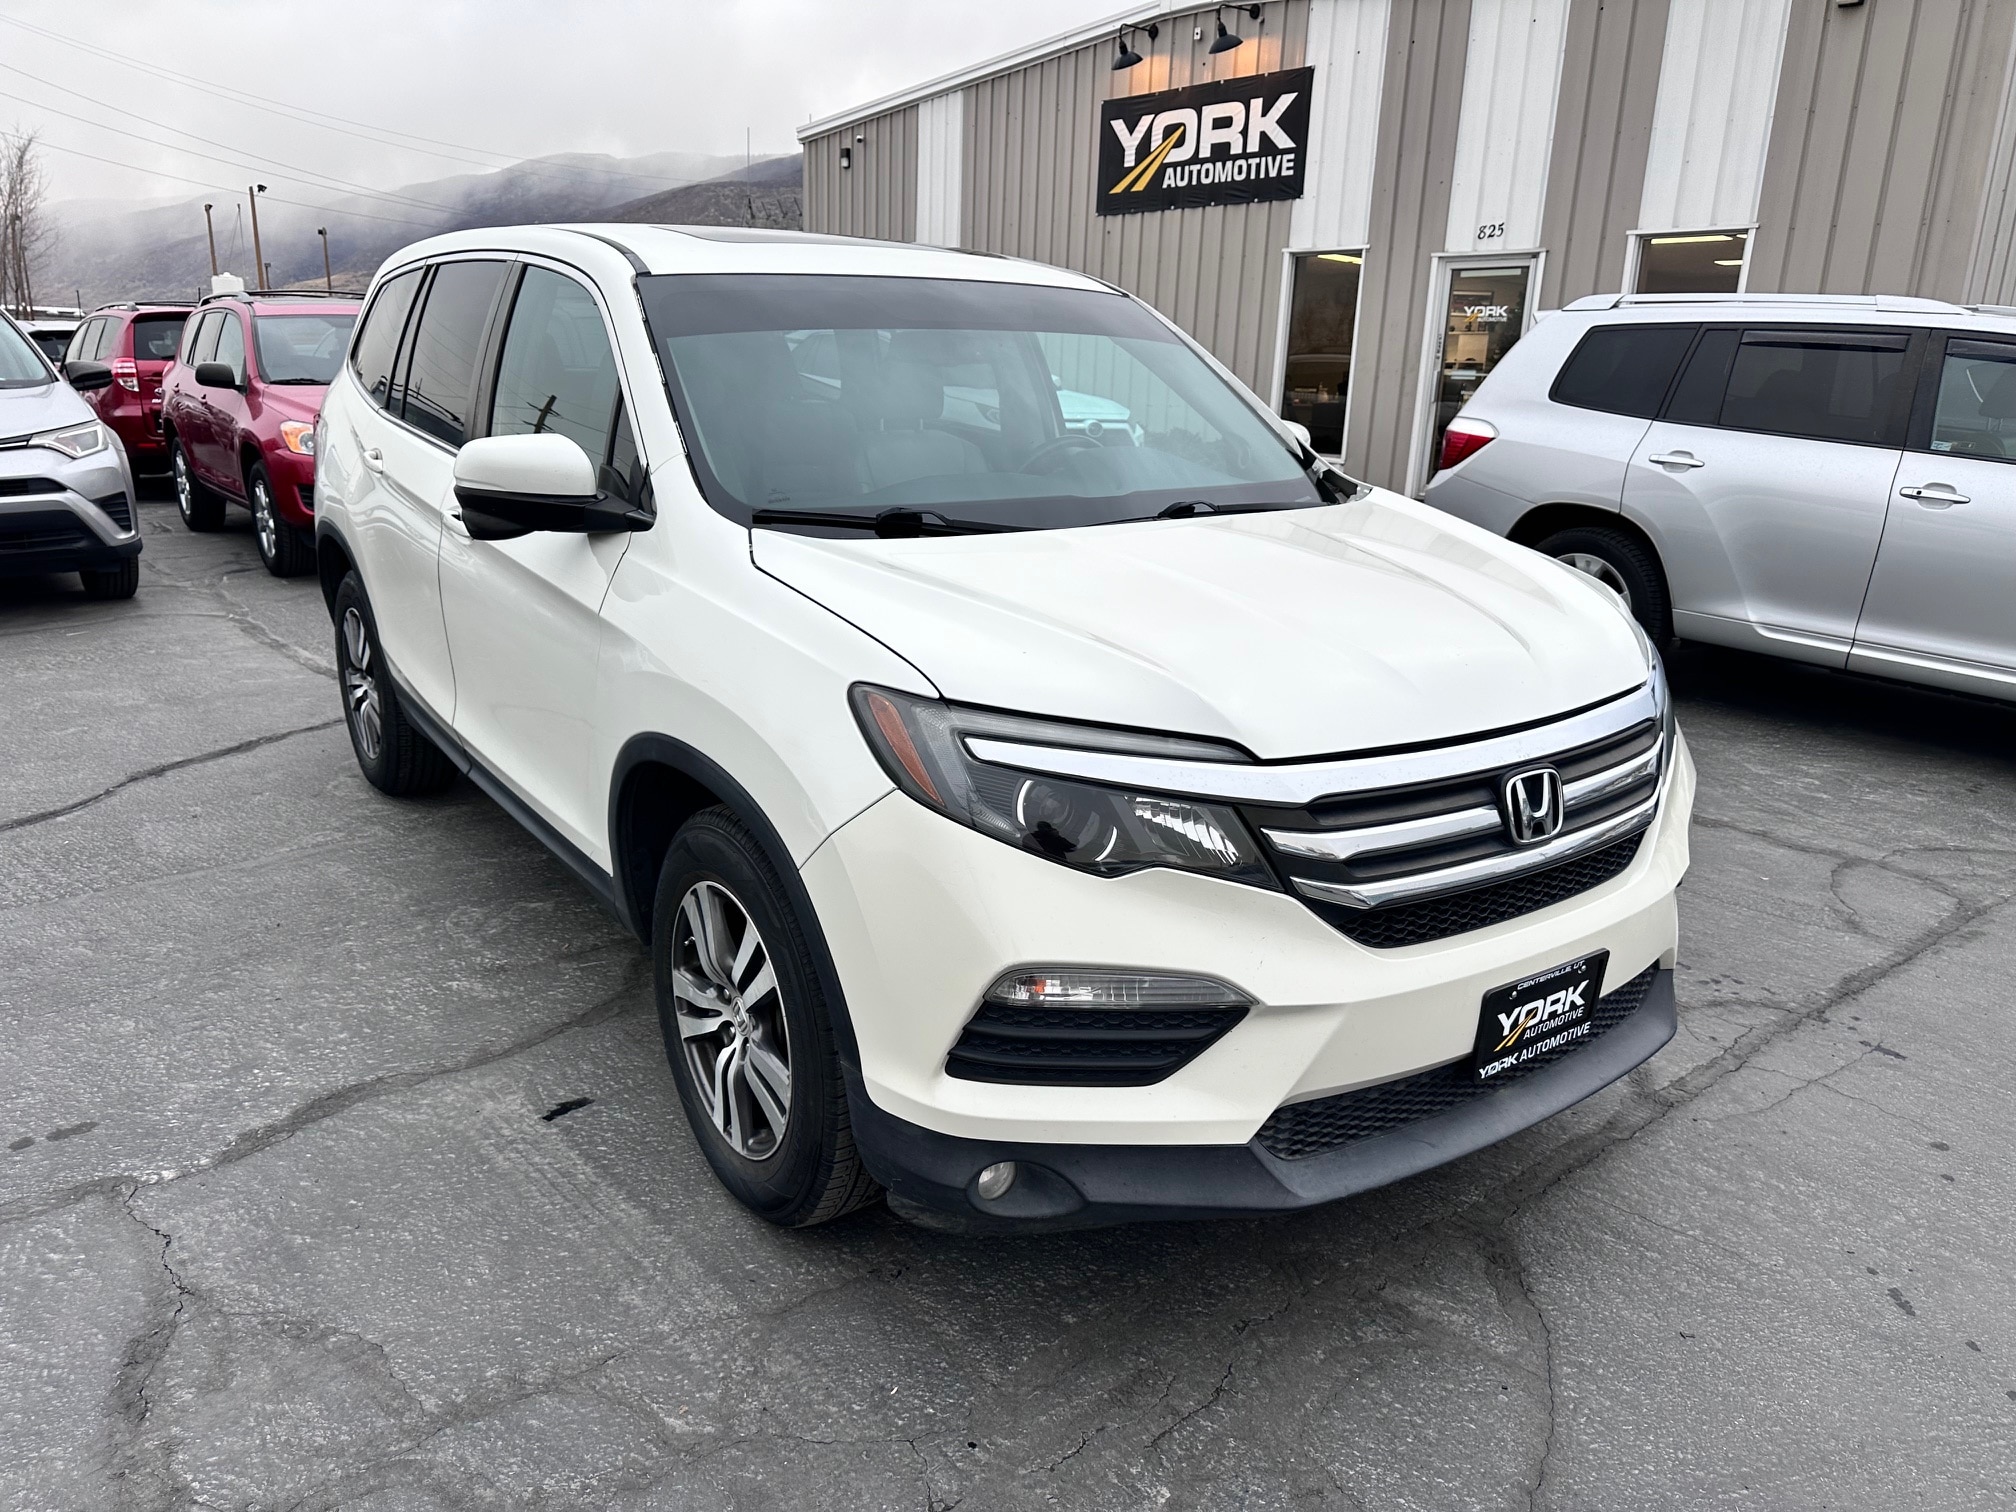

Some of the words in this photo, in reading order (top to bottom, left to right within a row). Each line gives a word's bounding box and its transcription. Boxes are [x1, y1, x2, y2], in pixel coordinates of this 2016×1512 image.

[1110, 92, 1298, 168] YORK
[1162, 153, 1296, 189] AUTOMOTIVE
[1477, 222, 1505, 240] 825
[1463, 305, 1509, 317] YORK
[1573, 959, 1585, 969] UT
[1497, 979, 1590, 1037] YORK
[1523, 1006, 1585, 1040] AUTOMOTIVE
[1478, 1052, 1519, 1079] YORK
[1518, 1021, 1592, 1063] AUTOMOTIVE
